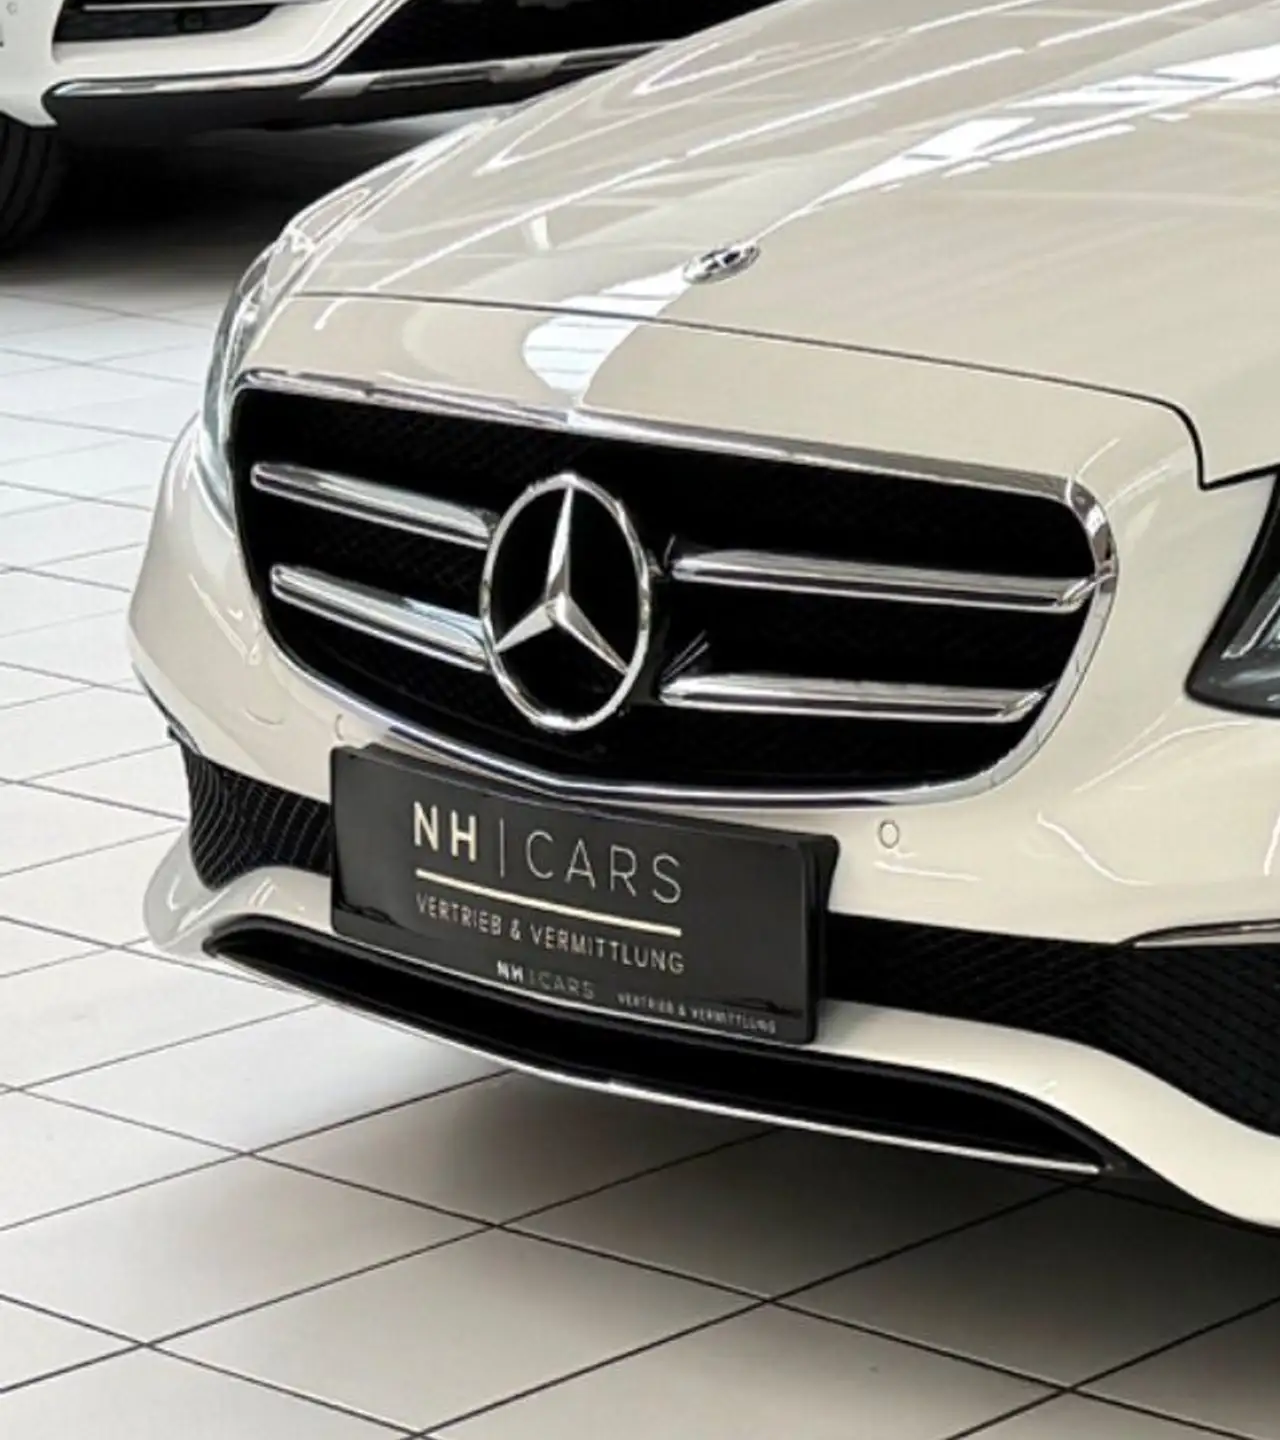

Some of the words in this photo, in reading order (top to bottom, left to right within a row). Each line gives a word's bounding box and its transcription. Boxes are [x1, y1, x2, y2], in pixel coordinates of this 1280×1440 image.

[413, 800, 477, 863] NH
[525, 829, 683, 905] CARS
[415, 892, 503, 937] VERTRIEB
[509, 918, 522, 941] &
[530, 922, 685, 975] VERMITTLUNG
[496, 959, 524, 984] NH
[537, 970, 596, 1000] CARS
